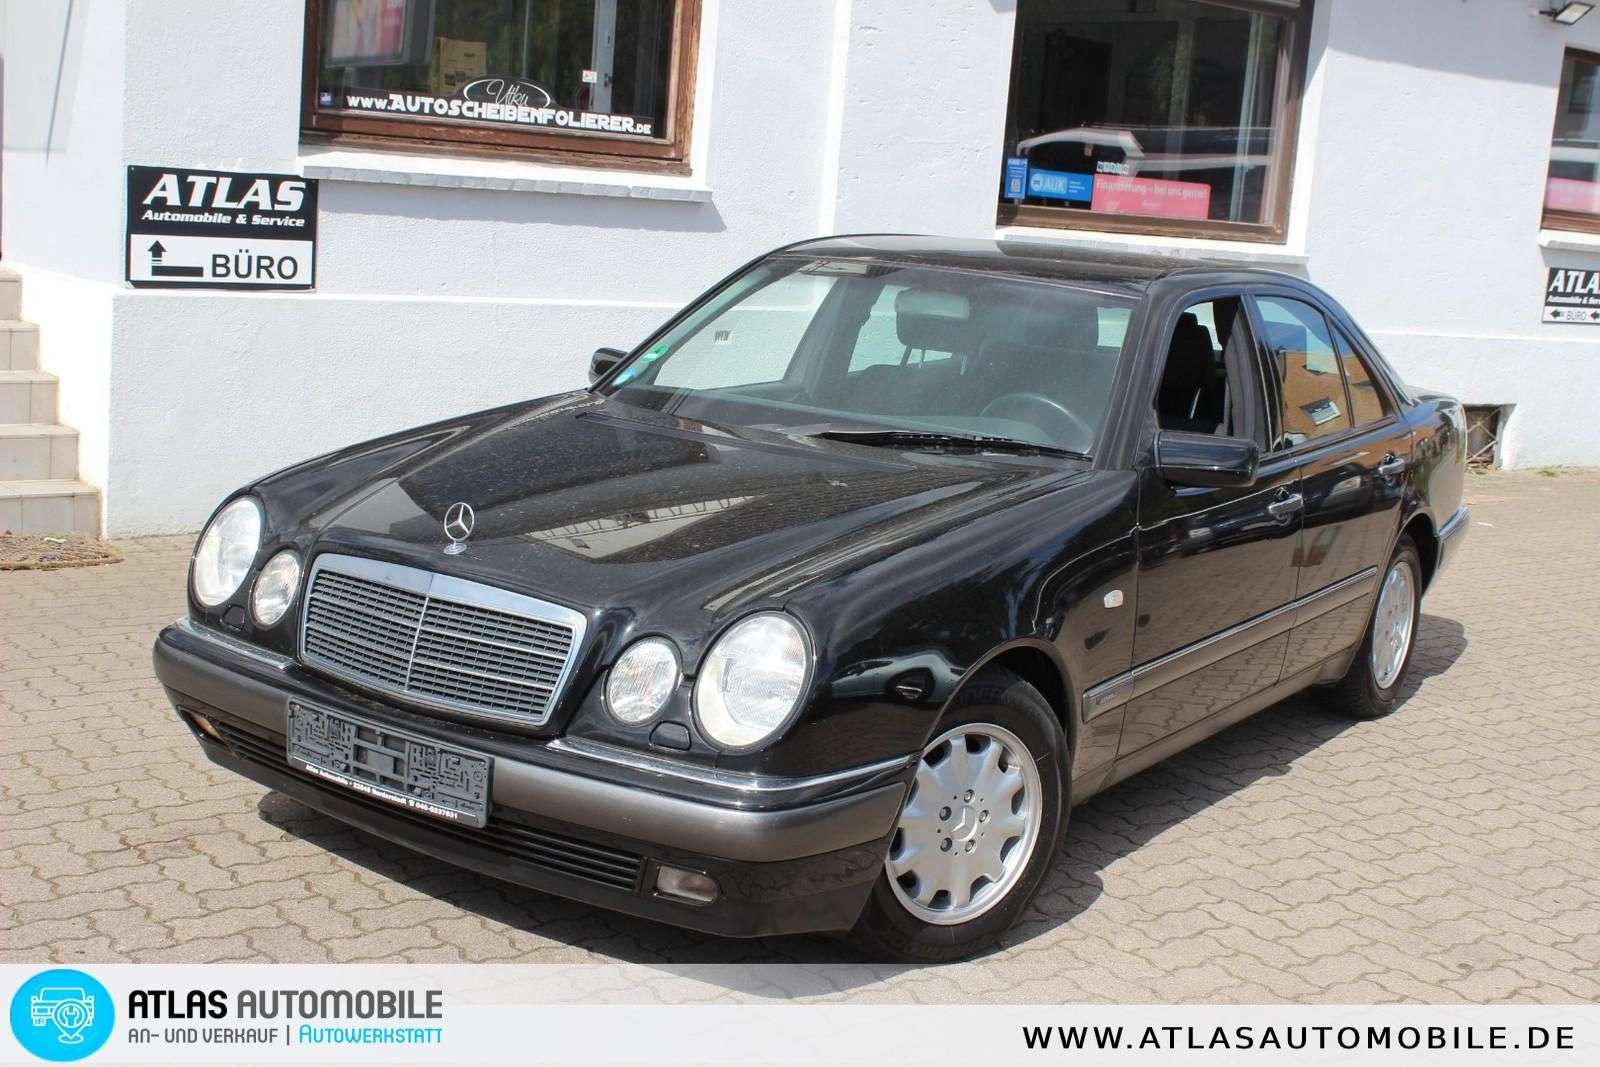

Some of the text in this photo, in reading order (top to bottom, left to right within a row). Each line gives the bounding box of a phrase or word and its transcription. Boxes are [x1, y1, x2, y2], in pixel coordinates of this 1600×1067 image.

[142, 173, 307, 212] ATLAS
[142, 209, 305, 228] Automobile & Service
[211, 249, 298, 280] BÜRO
[1549, 269, 1600, 294] ATLA
